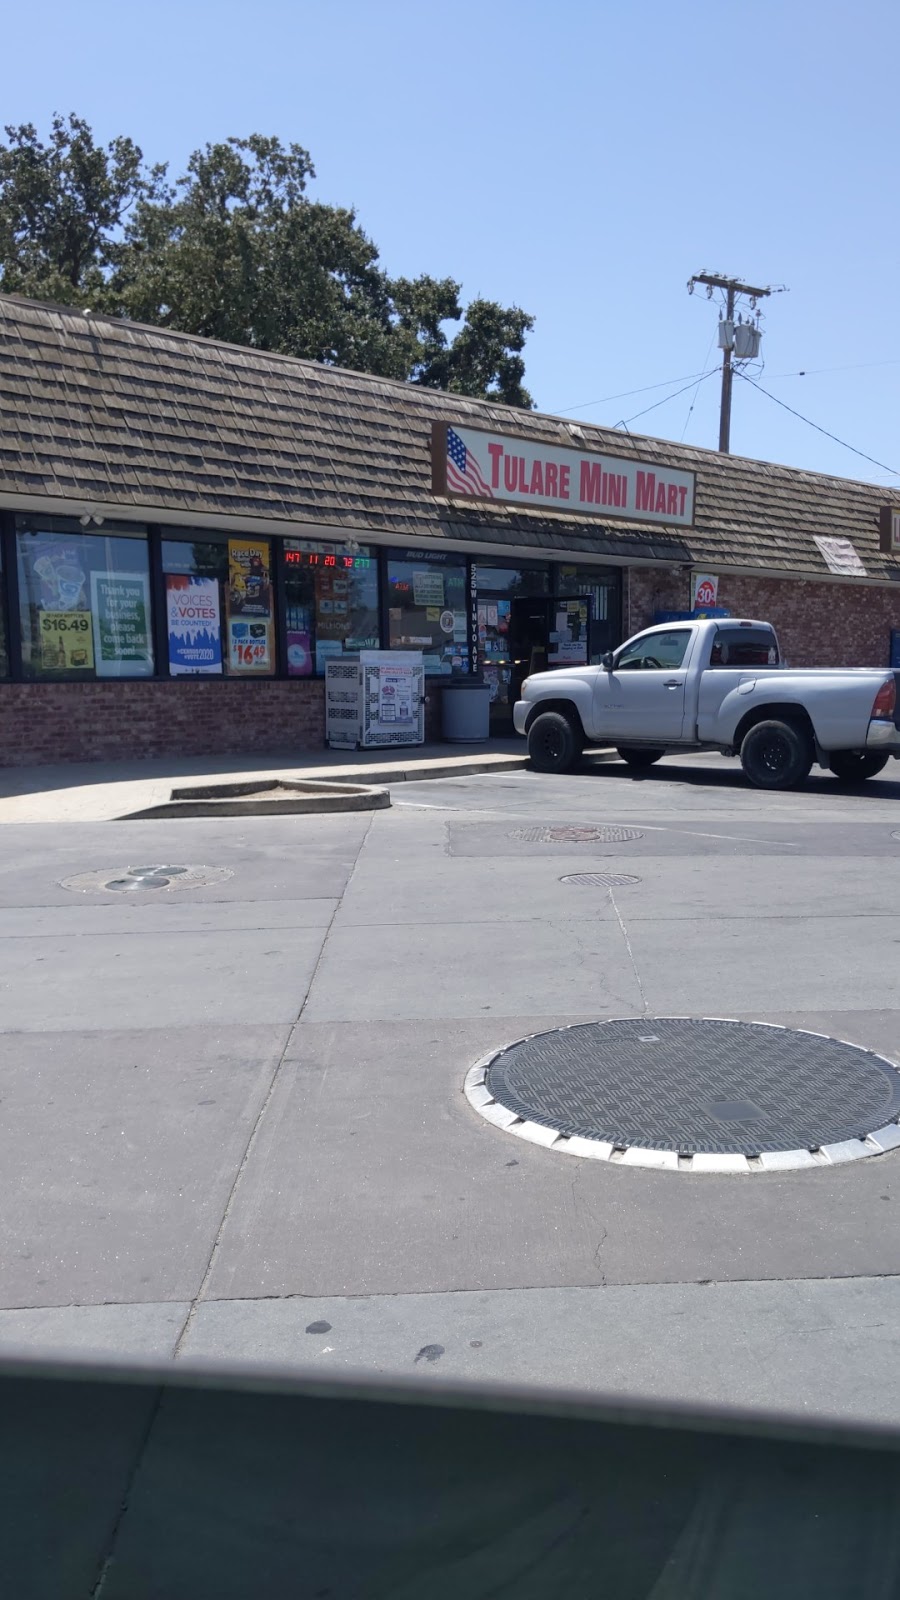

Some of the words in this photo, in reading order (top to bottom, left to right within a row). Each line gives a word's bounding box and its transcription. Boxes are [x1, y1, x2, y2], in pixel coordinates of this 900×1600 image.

[231, 548, 249, 557] Race
[249, 548, 263, 559] Day
[424, 552, 447, 560] LIGHT
[285, 552, 300, 562] 147
[309, 554, 318, 565] 11
[325, 556, 336, 566] 20
[343, 557, 353, 567] 72
[354, 558, 370, 568] 277
[100, 584, 125, 596] Thank
[125, 588, 140, 598] you
[107, 596, 118, 607] for
[120, 599, 137, 610] your
[173, 594, 213, 607] VOICES
[105, 609, 141, 621] business,
[170, 606, 178, 617] &
[178, 607, 216, 618] VOTES
[42, 619, 89, 631] $16.49
[111, 622, 136, 634] please
[181, 619, 212, 627] COUNTED!
[104, 635, 125, 644] come
[126, 634, 144, 644] back
[115, 647, 136, 656] soon!
[199, 648, 214, 660] 2020
